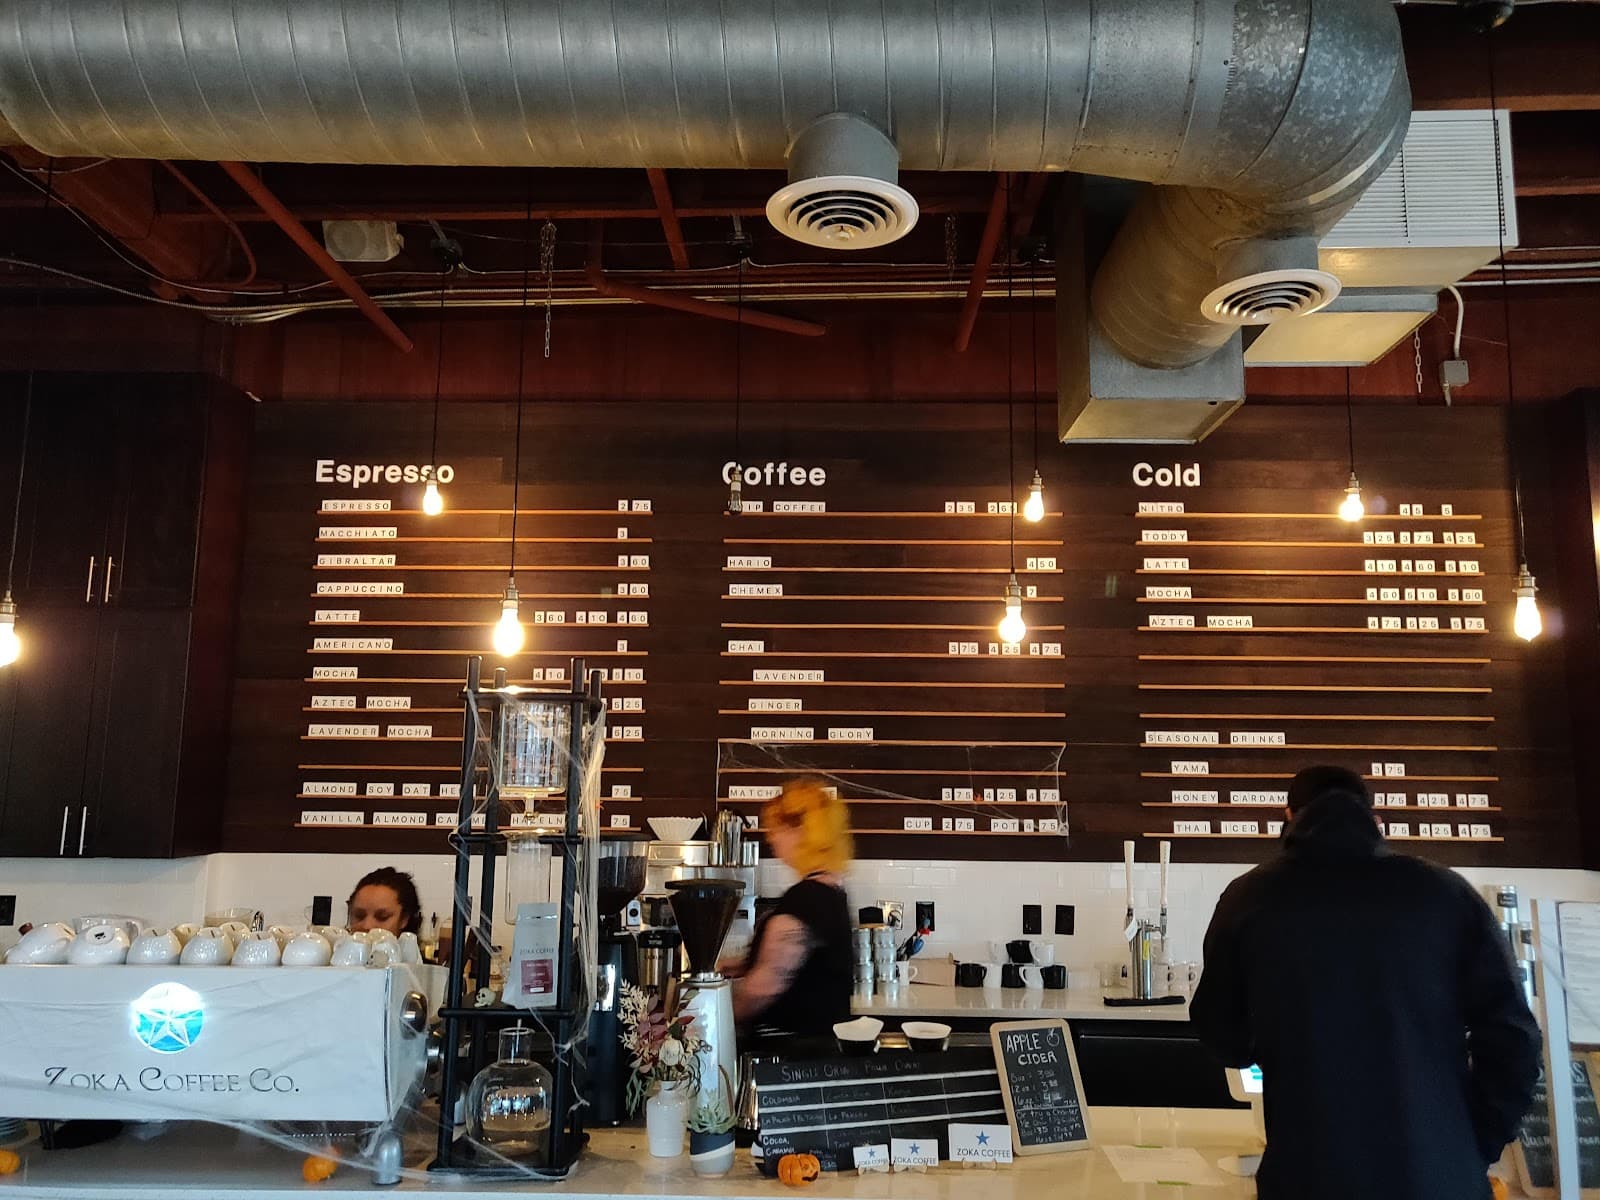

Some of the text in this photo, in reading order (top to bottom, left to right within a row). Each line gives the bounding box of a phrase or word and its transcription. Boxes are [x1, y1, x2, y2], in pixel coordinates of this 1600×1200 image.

[315, 459, 454, 489] Espresso
[722, 461, 826, 486] Coffee
[1132, 462, 1201, 487] Cold
[323, 502, 390, 510] ESPRESSO
[1140, 504, 1183, 513] NITRO
[320, 529, 395, 537] MACCHIATO
[1144, 532, 1186, 541] TODDY
[319, 557, 394, 565] GIBRALTAR
[729, 559, 770, 567] HARIO
[1146, 561, 1187, 569] LATTE
[318, 585, 402, 593] CAPPUCCINO
[1147, 589, 1190, 597] MOCHA
[1151, 618, 1193, 626] AZTEC
[1208, 618, 1251, 627] MOCHA
[315, 641, 391, 649] AMERICANO
[730, 643, 762, 651] CHAI
[314, 670, 356, 678] MOCHA
[755, 672, 822, 680] LAVENDER
[313, 699, 354, 707] AZTEC
[367, 700, 409, 708] MOCHA
[750, 702, 800, 710] GINGER
[310, 728, 377, 736] LAVENDER
[388, 729, 430, 737] MOCHA
[752, 730, 872, 739] MORNING GLORY
[1147, 735, 1284, 743] SEASONAL DRINKS
[1173, 764, 1207, 772] YAMA
[304, 786, 355, 794] ALMOND
[368, 786, 393, 794] SOY
[1174, 793, 1217, 801] HONEY
[1232, 794, 1287, 802] CARDAM
[303, 814, 362, 822] VANILLA
[375, 815, 425, 823] ALMOND
[905, 820, 931, 829] CUP
[993, 822, 1018, 830] POT
[1175, 824, 1208, 832] THAI
[1225, 824, 1257, 833] ICED
[1006, 1033, 1042, 1054] APPLE
[1017, 1051, 1058, 1066] CIDER
[956, 1148, 1011, 1158] ZOKA COFFEE
[893, 1156, 937, 1165] ZOKA COFFEE
